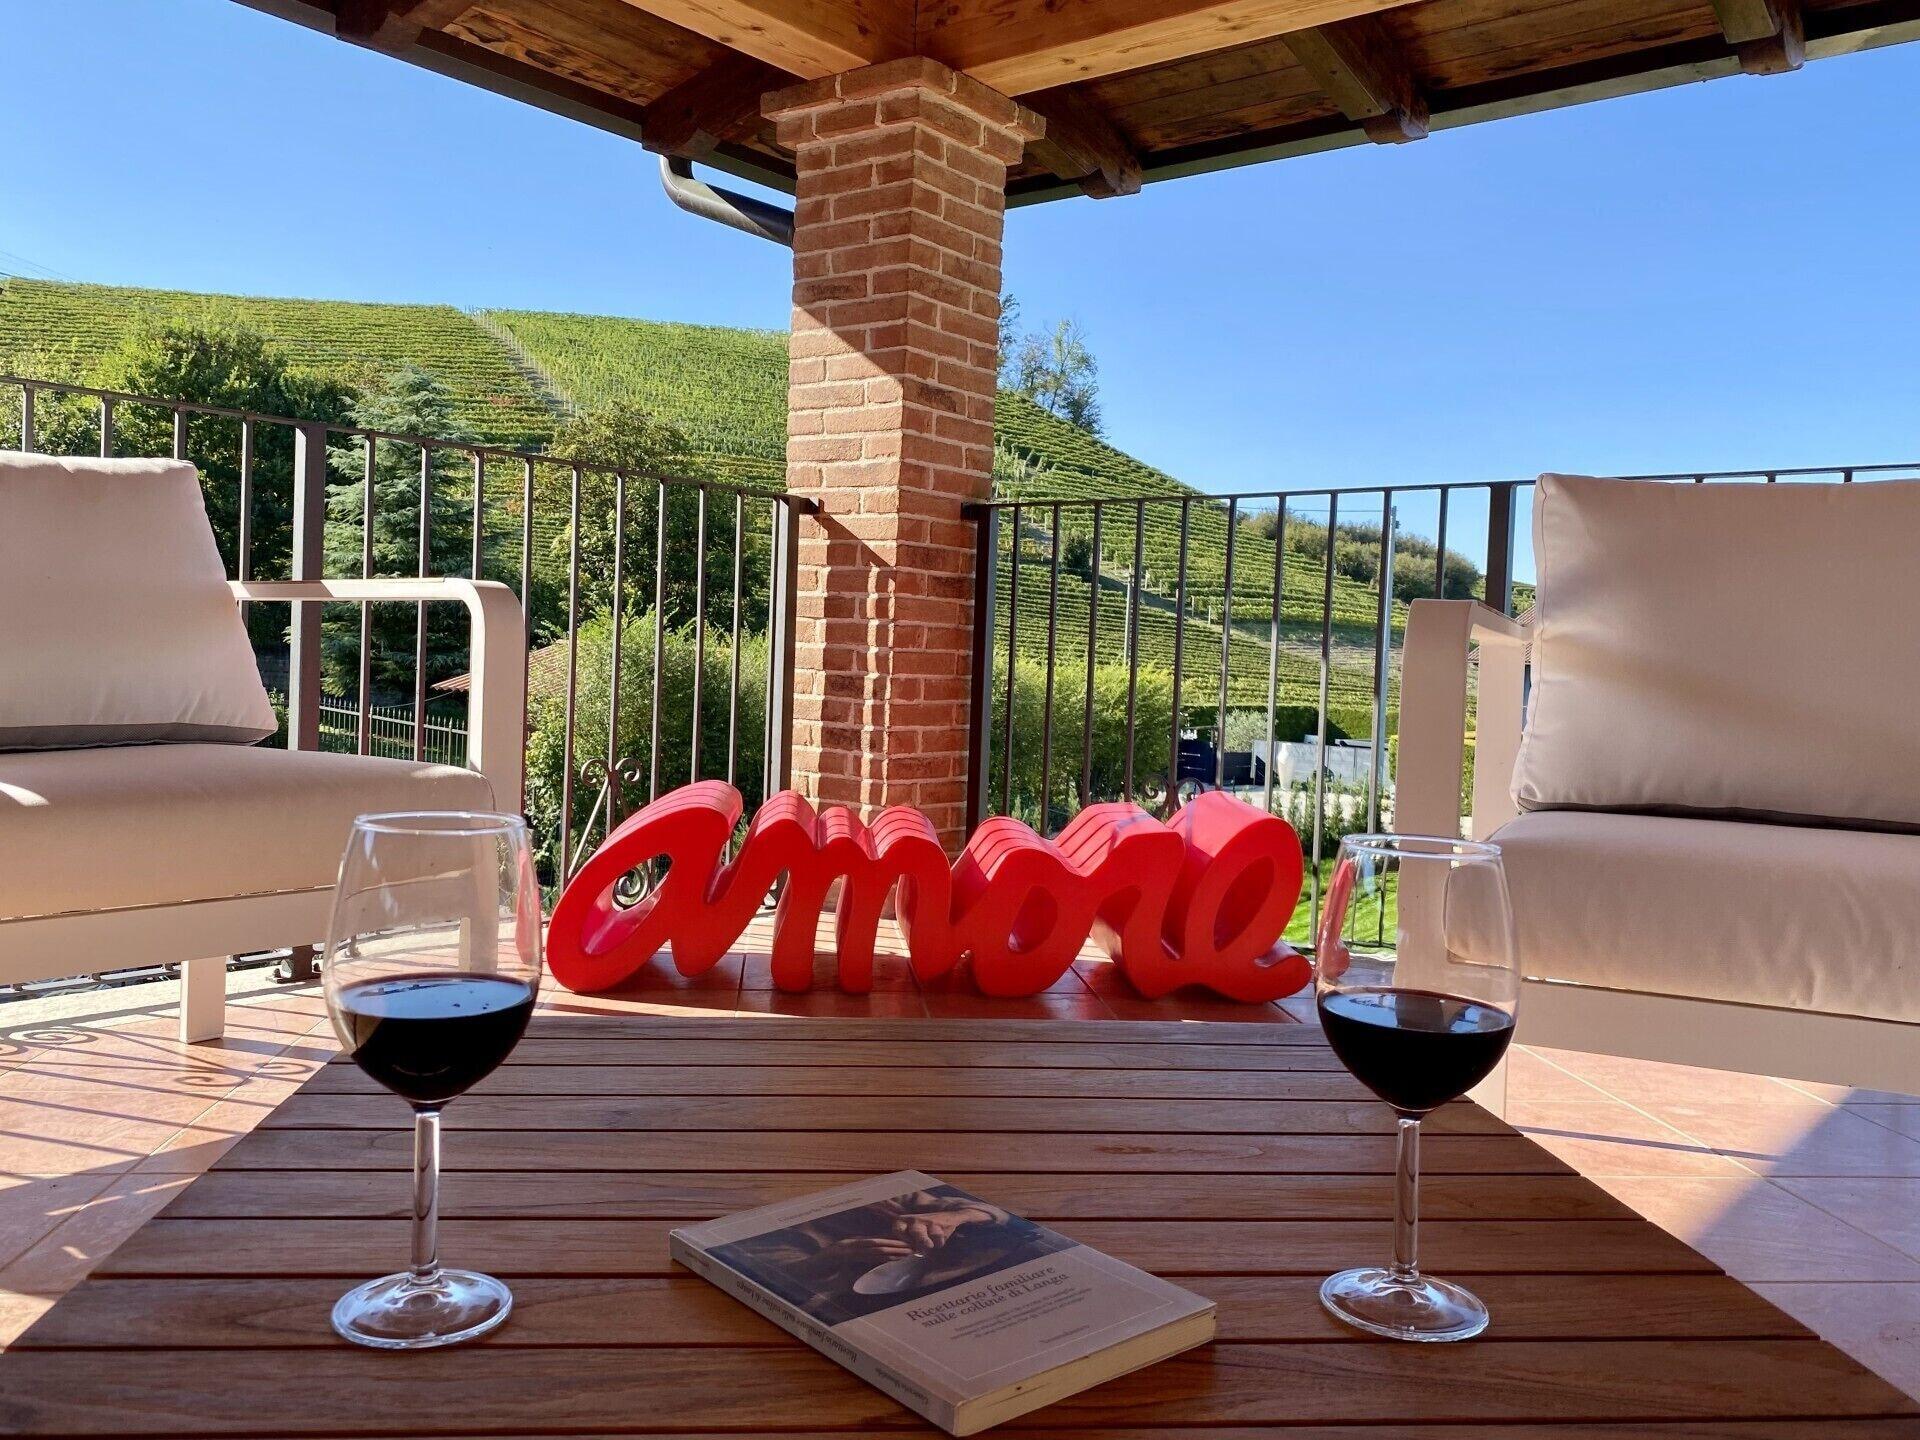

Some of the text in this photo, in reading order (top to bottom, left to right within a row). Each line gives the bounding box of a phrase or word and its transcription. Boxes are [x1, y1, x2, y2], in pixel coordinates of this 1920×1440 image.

[546, 778, 1311, 1003] amore
[906, 1291, 986, 1321] Ricettario
[986, 1266, 1056, 1297] familiare
[921, 1311, 957, 1328] sulle
[960, 1295, 1005, 1316] colline
[1009, 1287, 1021, 1298] di
[1024, 1273, 1070, 1296] Langa
